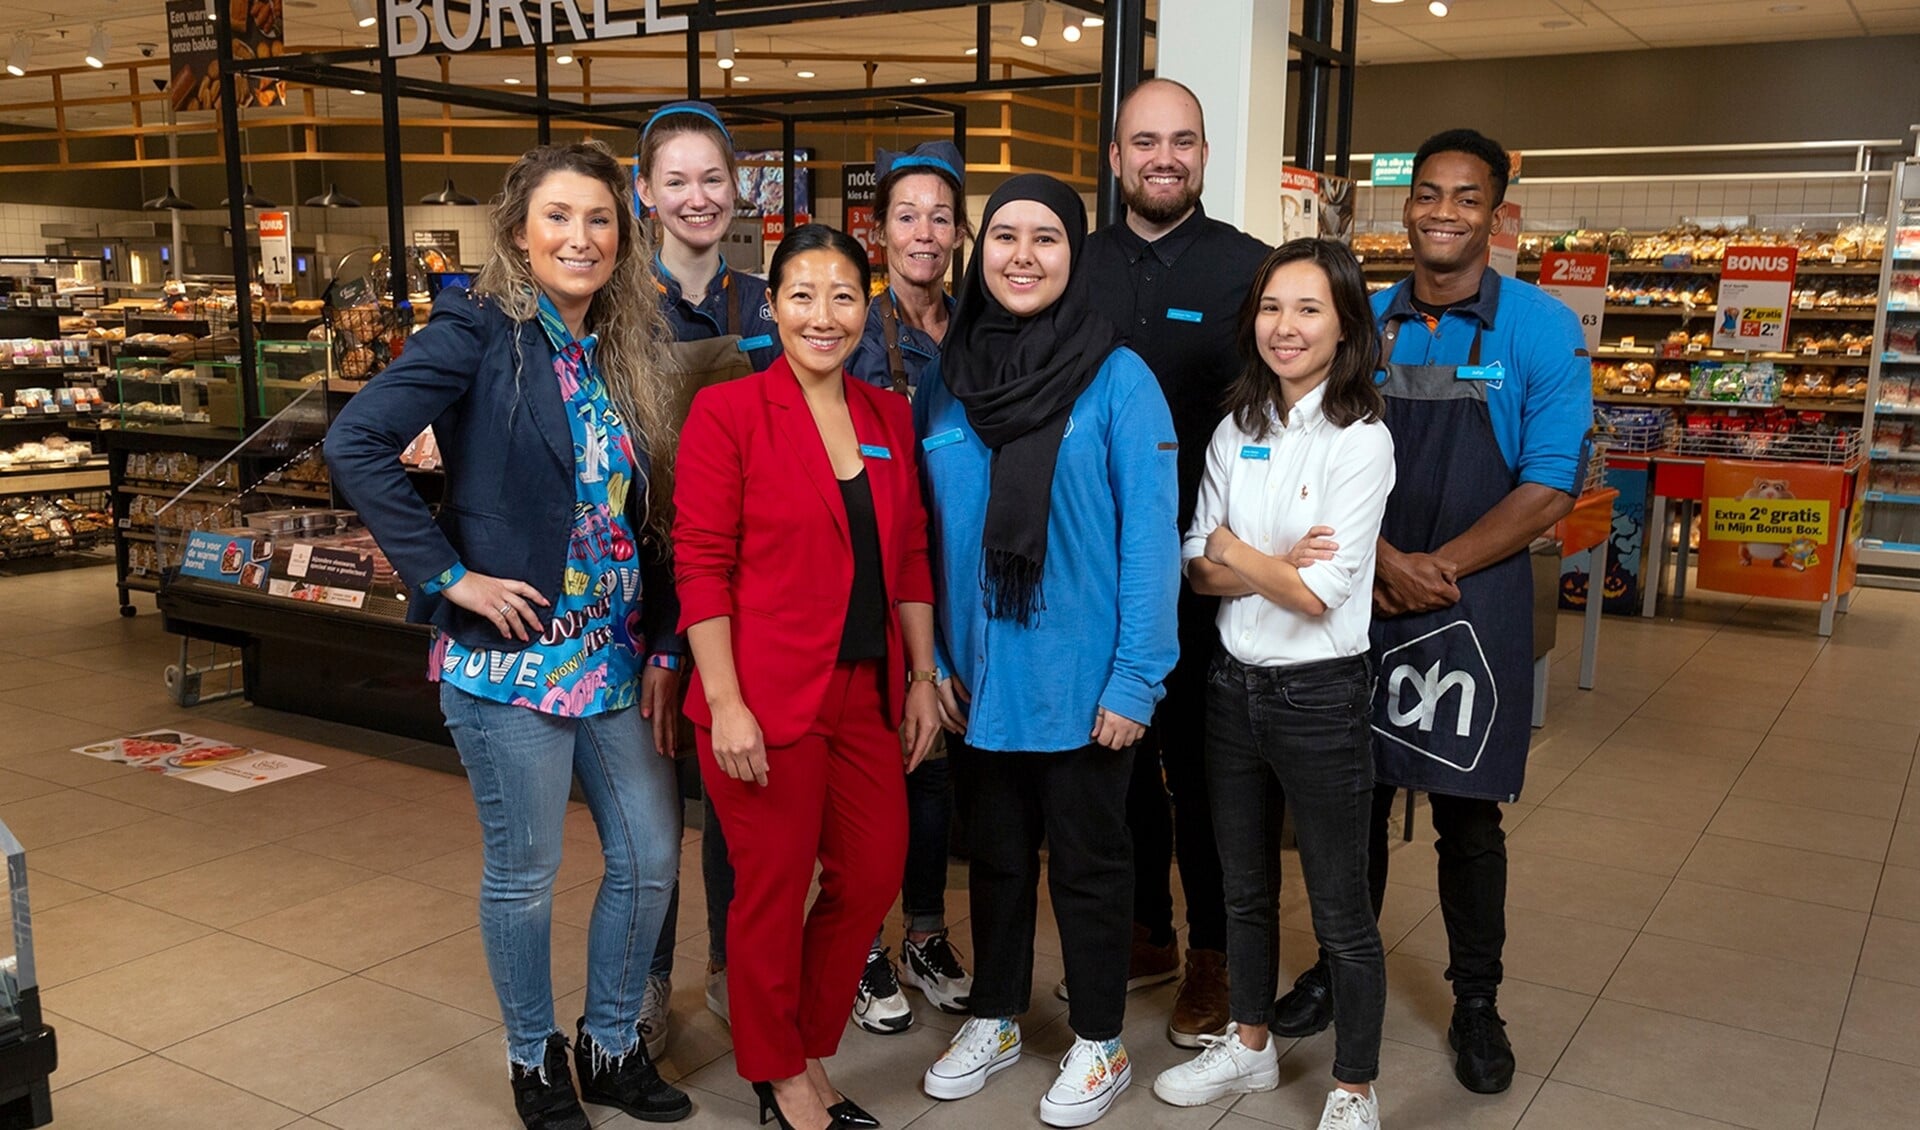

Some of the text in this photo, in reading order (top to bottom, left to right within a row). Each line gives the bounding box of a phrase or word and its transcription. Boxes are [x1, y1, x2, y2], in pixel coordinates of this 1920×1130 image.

[169, 11, 186, 23] Een
[171, 22, 214, 38] welkom in
[172, 42, 191, 53] onze
[853, 211, 860, 223] 3
[1569, 264, 1597, 273] HALVE
[1726, 255, 1789, 272] BONUS
[1582, 314, 1598, 326] 63
[1756, 310, 1783, 320] gratis
[1715, 510, 1745, 521] Extra
[1770, 508, 1821, 525] gratis
[1714, 521, 1822, 536] in Mijn Bonus Box.
[206, 542, 222, 551] voor
[187, 548, 197, 558] de
[443, 637, 544, 688] LOVE
